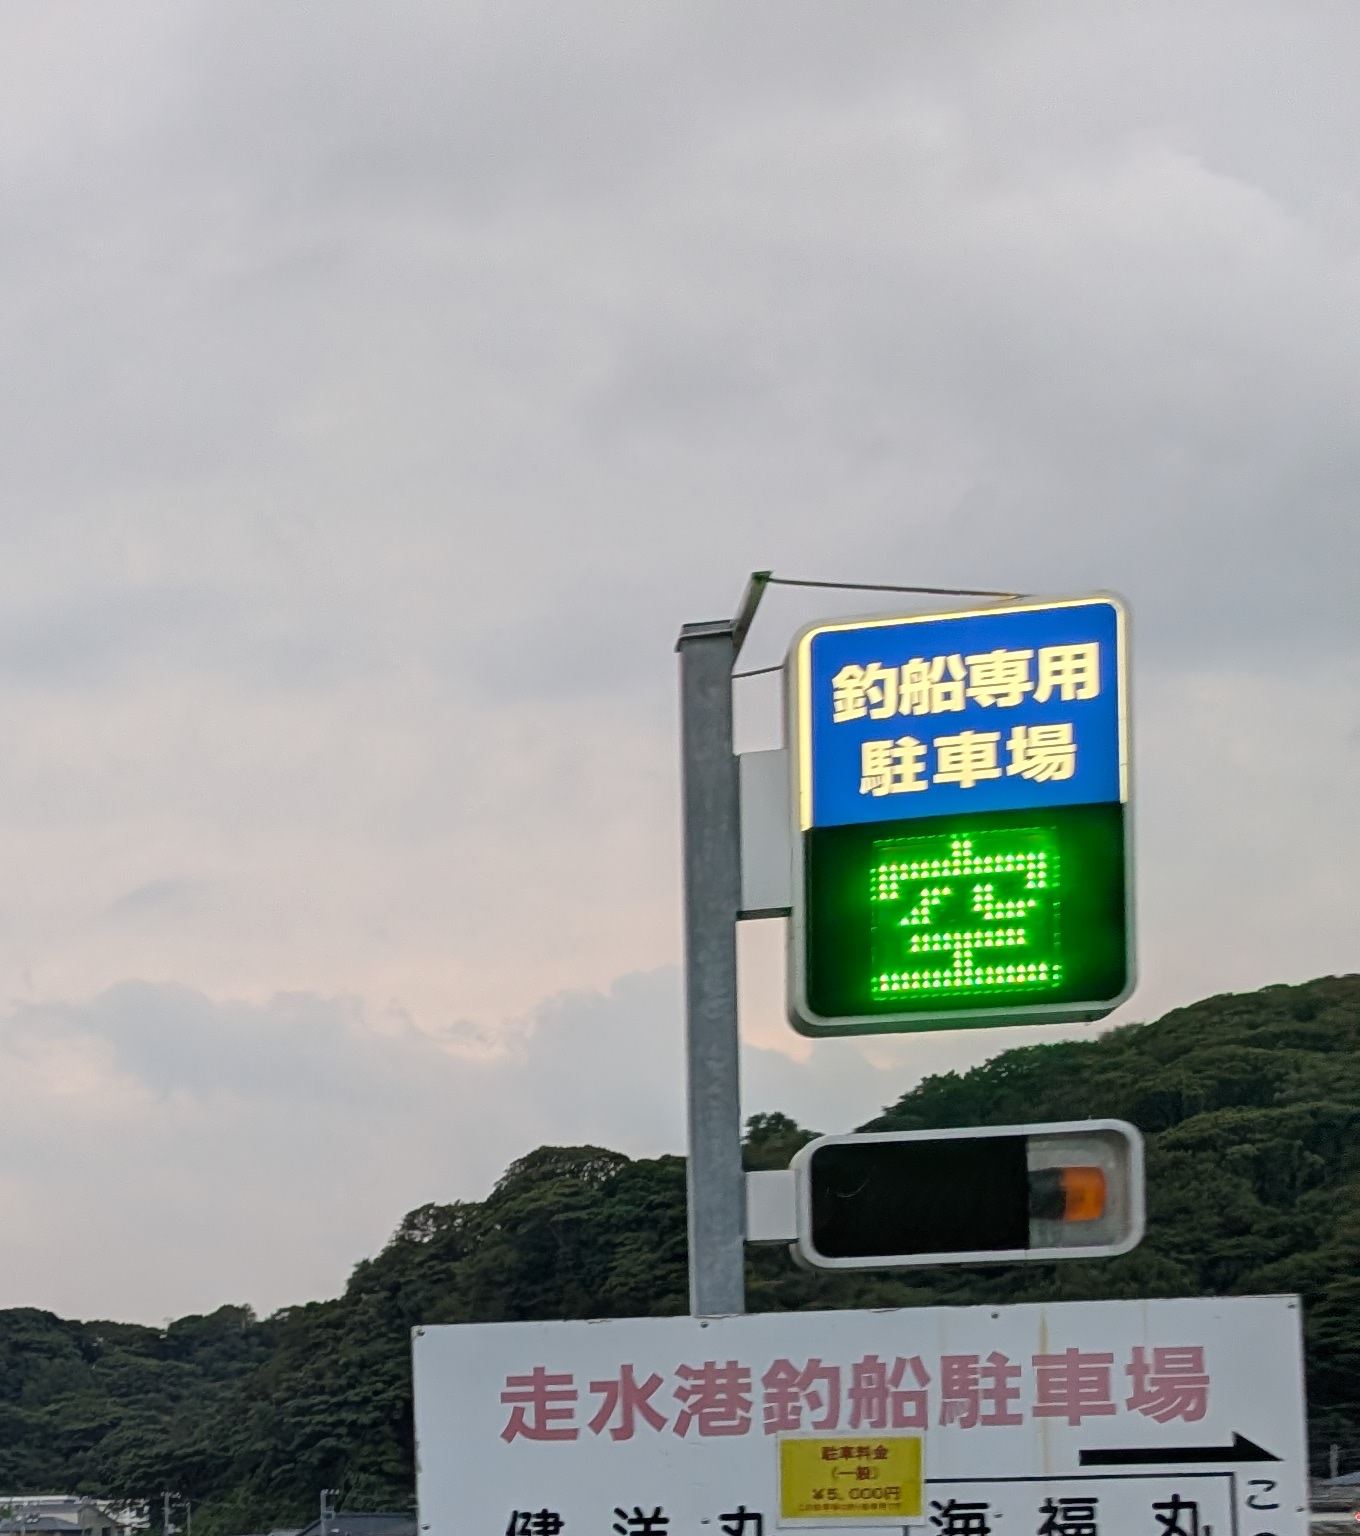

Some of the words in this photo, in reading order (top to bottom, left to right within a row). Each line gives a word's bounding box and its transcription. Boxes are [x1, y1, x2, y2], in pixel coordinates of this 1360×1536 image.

[831, 642, 1100, 723] 釣船専用
[859, 723, 1077, 796] 駐車場
[879, 839, 1049, 991] 空
[500, 1346, 1211, 1443] 走水港釣船駐車場
